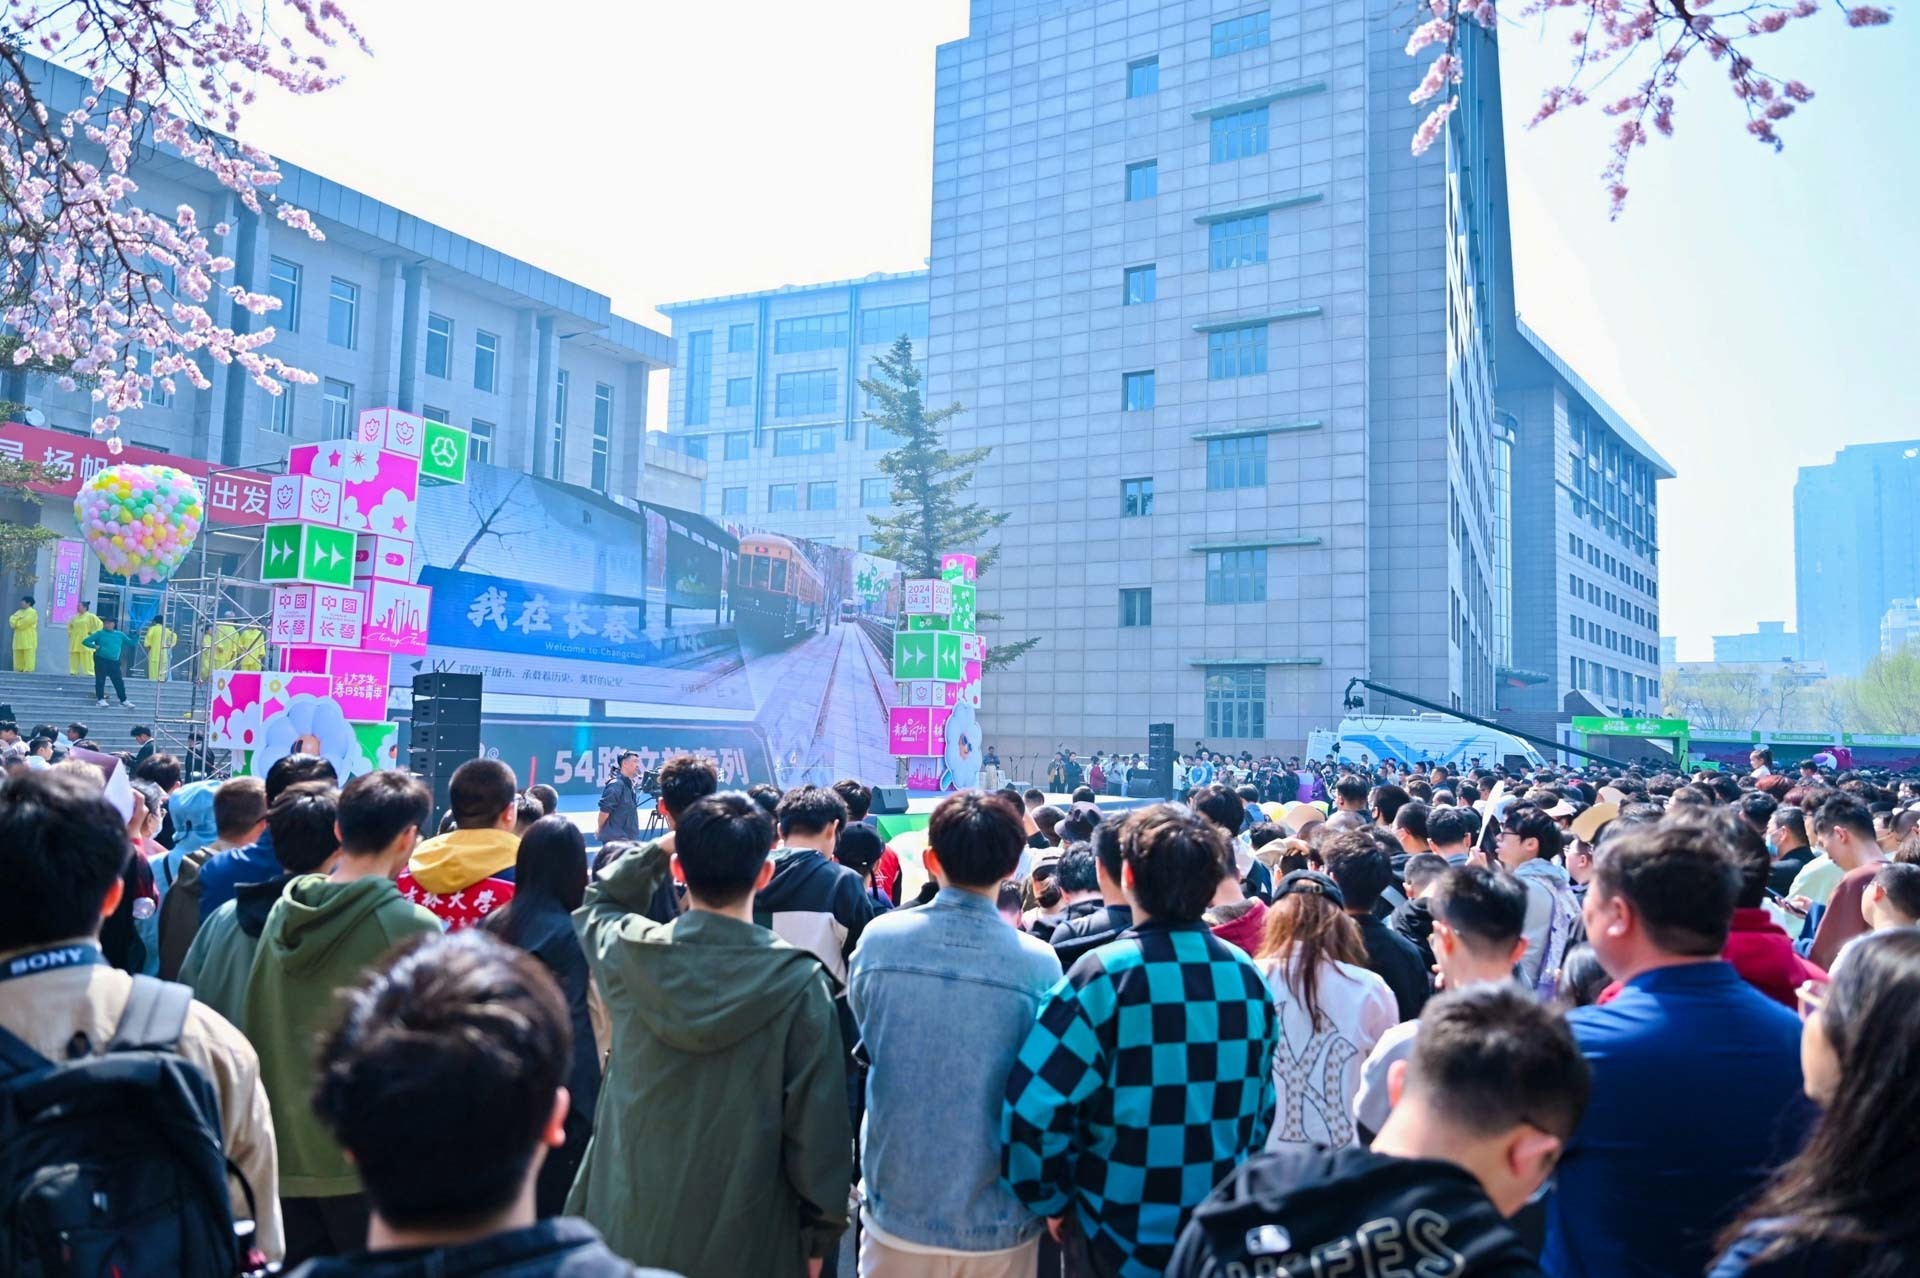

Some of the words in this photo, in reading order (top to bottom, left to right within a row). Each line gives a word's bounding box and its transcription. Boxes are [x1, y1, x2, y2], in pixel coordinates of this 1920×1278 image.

[908, 584, 930, 594] 2024
[279, 593, 308, 609] 中国
[321, 595, 358, 614] 中国
[277, 619, 305, 636] 长春
[320, 620, 356, 639] 长春
[544, 640, 587, 656] Welcome
[589, 647, 598, 655] to
[600, 647, 647, 662] Changchun
[10, 947, 83, 976] SONY
